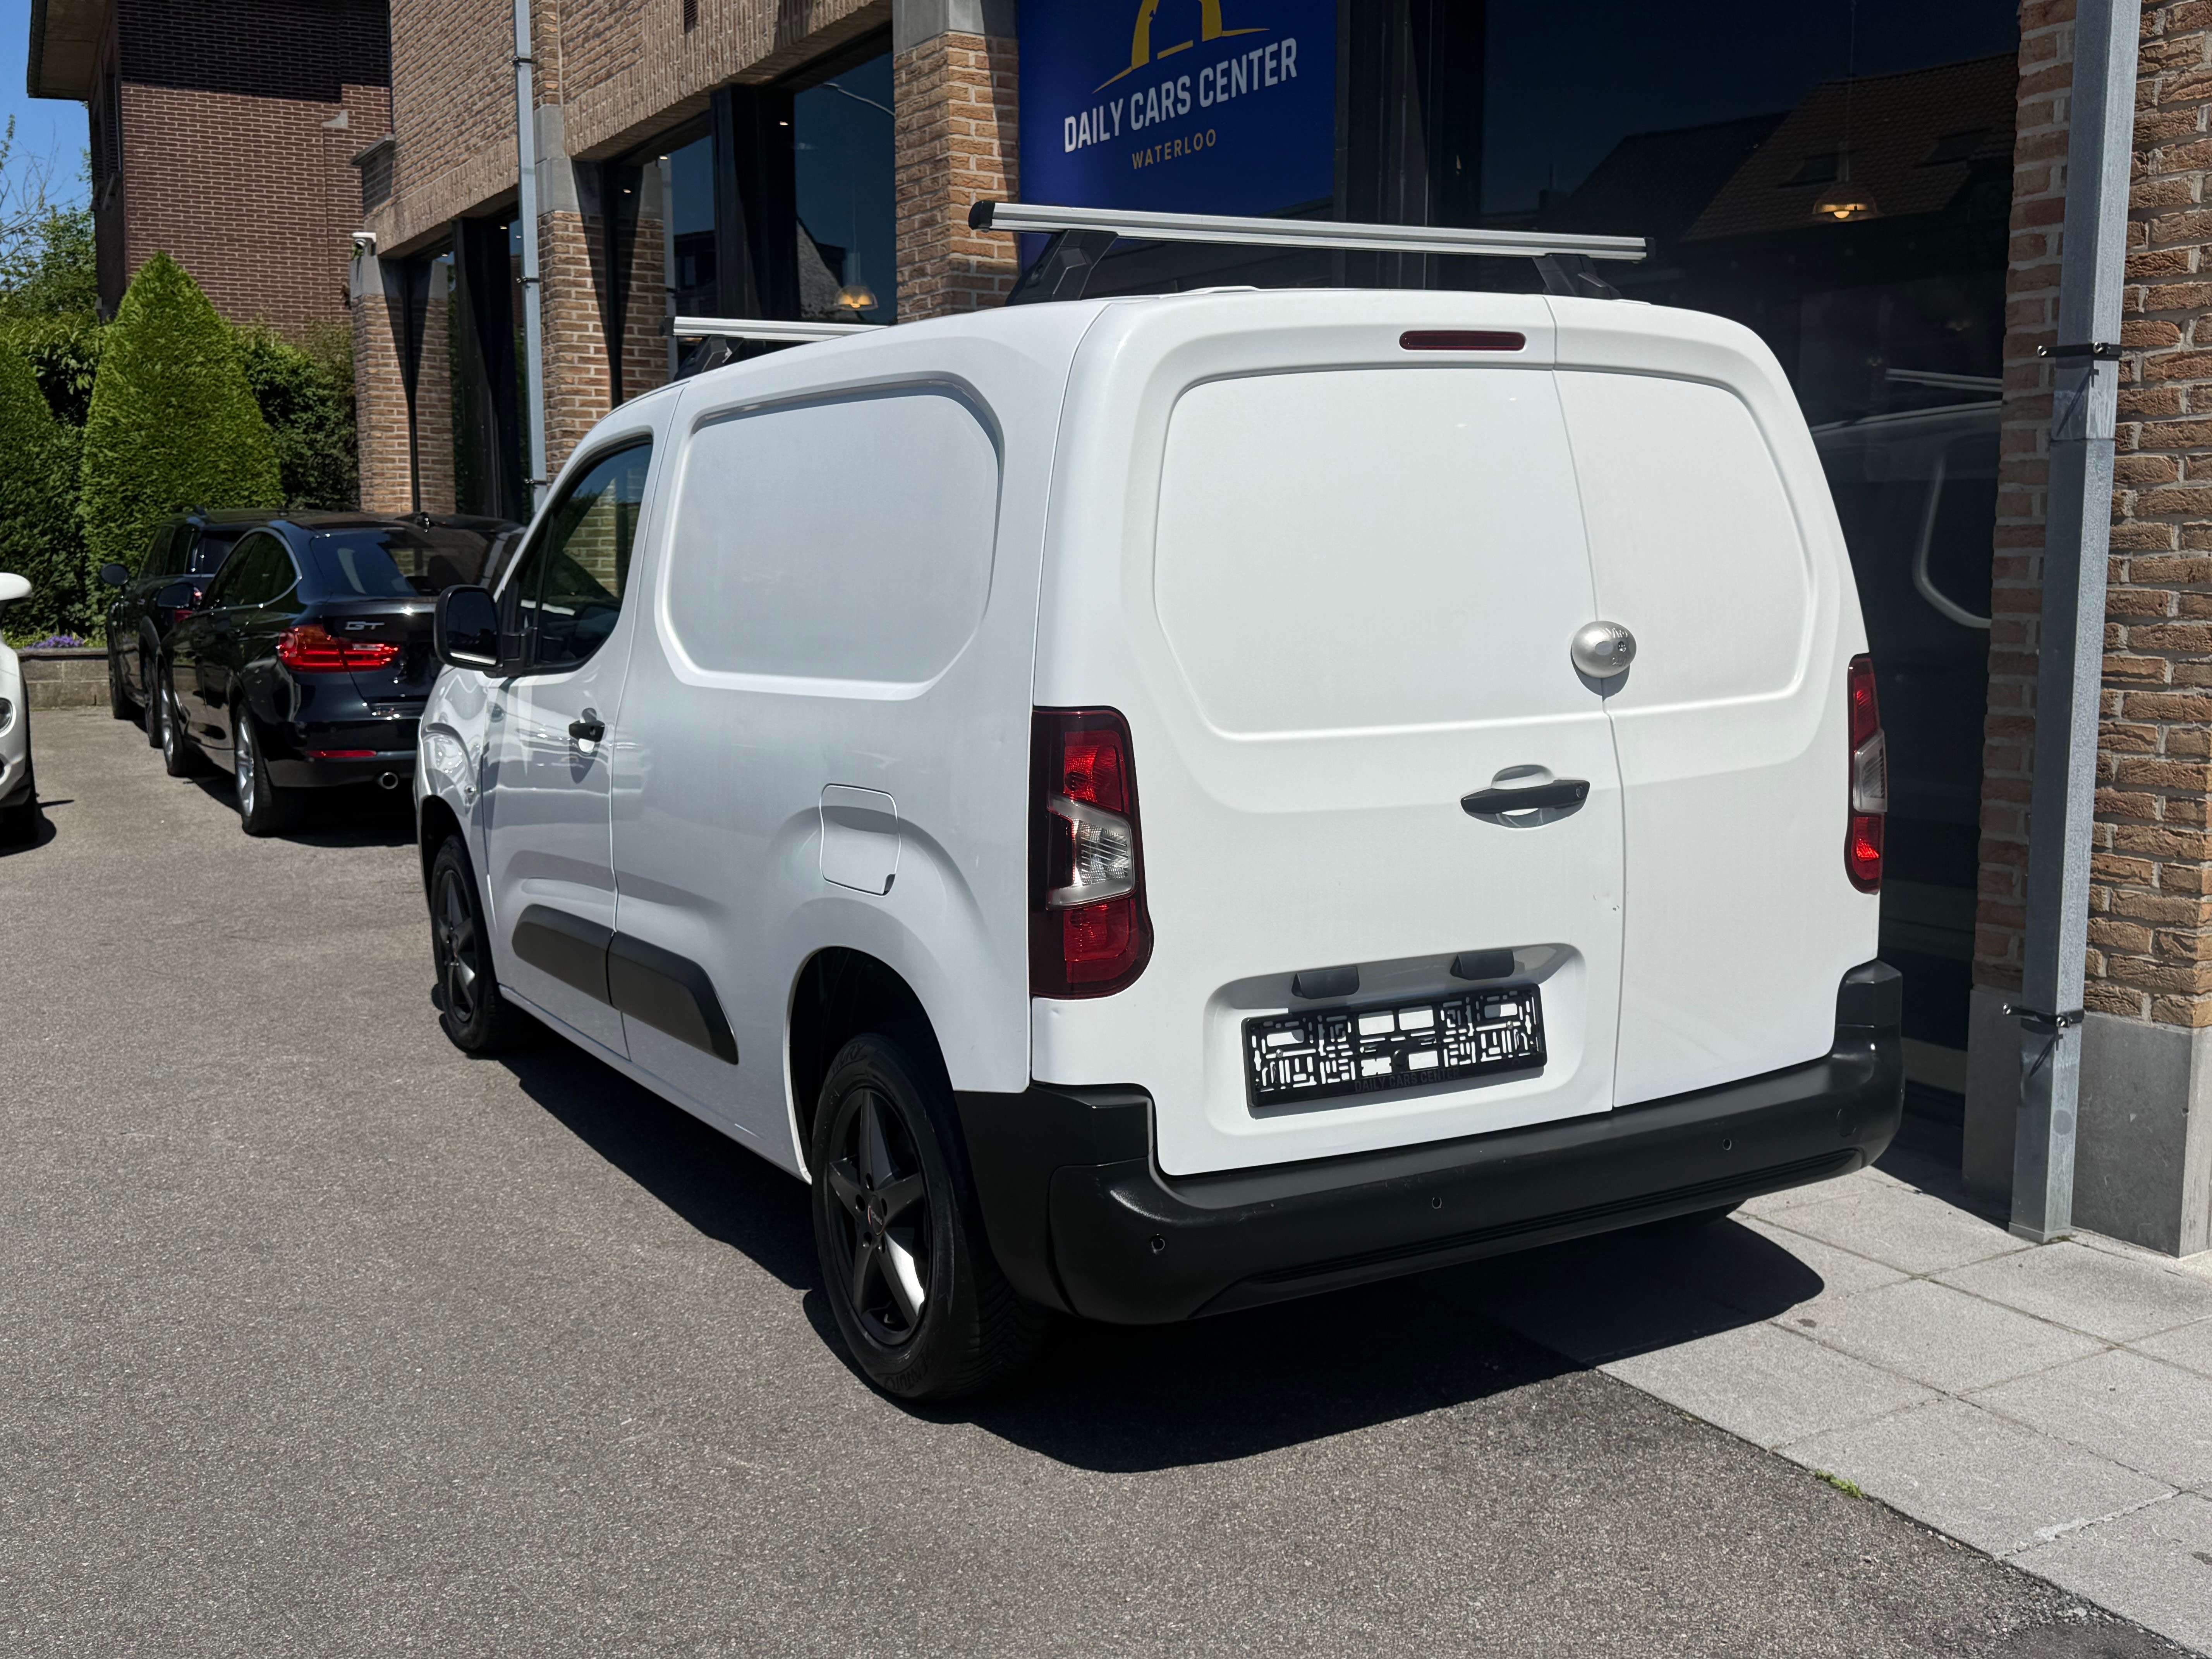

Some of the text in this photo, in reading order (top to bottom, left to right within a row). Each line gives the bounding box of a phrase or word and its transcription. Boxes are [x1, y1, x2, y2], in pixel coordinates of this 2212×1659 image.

[1064, 38, 1298, 153] DAILY CARS CENTER
[1132, 129, 1216, 170] WATERLOO
[344, 621, 385, 630] GT
[1354, 1067, 1460, 1092] DAILY CARS CENTER
